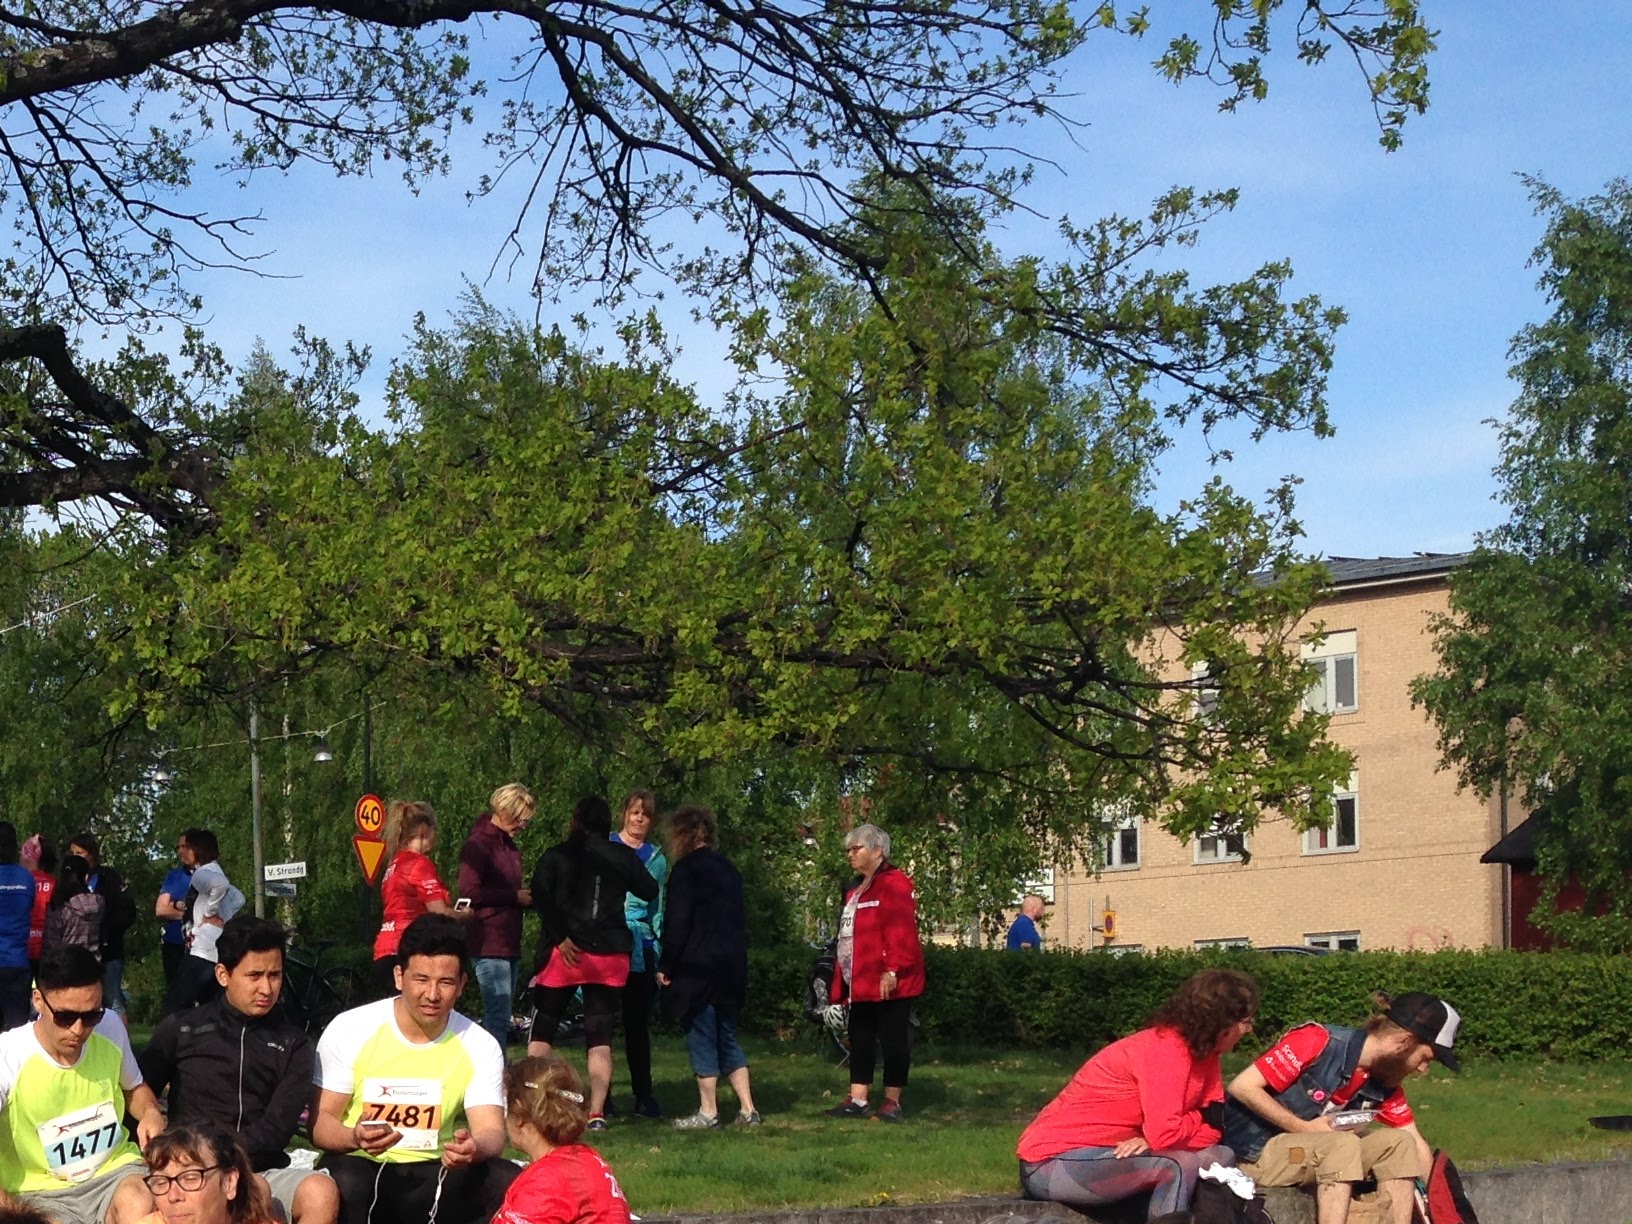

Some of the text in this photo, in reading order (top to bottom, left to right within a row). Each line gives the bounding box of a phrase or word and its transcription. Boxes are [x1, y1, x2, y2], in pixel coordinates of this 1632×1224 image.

[361, 804, 381, 826] 40
[370, 1103, 436, 1130] 7481
[52, 1121, 118, 1166] 1477
